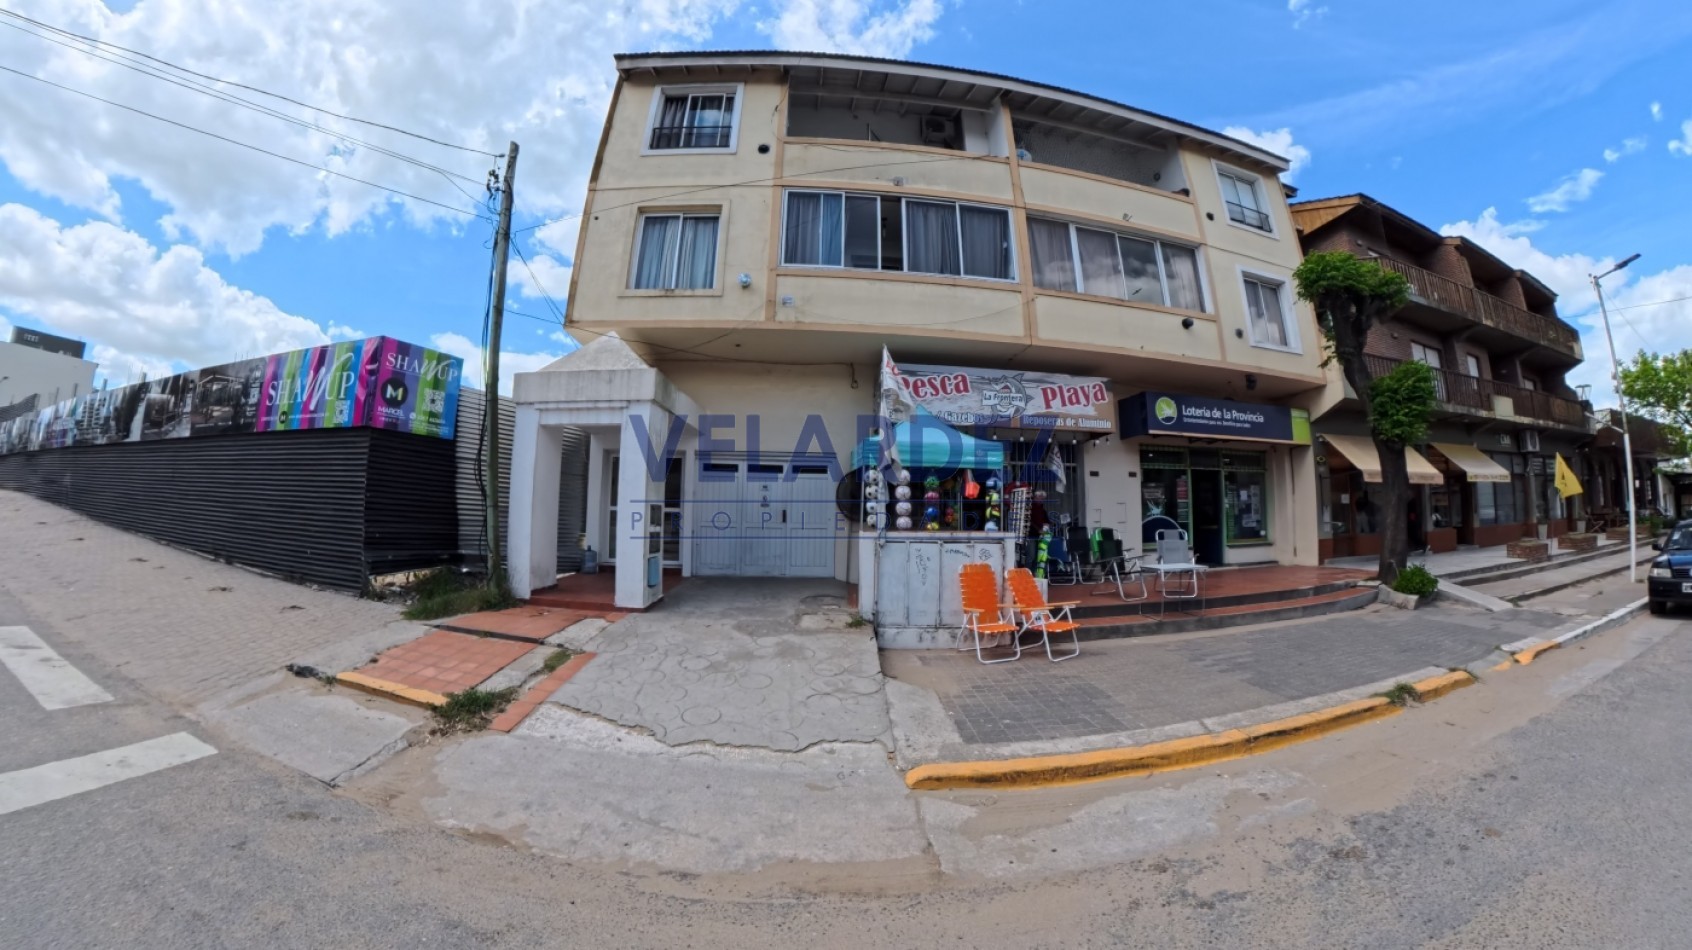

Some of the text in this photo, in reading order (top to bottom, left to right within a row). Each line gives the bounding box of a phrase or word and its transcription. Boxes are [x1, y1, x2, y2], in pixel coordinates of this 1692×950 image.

[386, 384, 404, 401] M
[983, 392, 1024, 403] La Frontera
[1040, 381, 1108, 410] Playa
[1023, 414, 1112, 429] Reposeras de Aluminio
[1182, 405, 1211, 418] Lotería
[1212, 407, 1222, 419] de
[1223, 408, 1231, 419] la
[1232, 410, 1264, 423] Provincia
